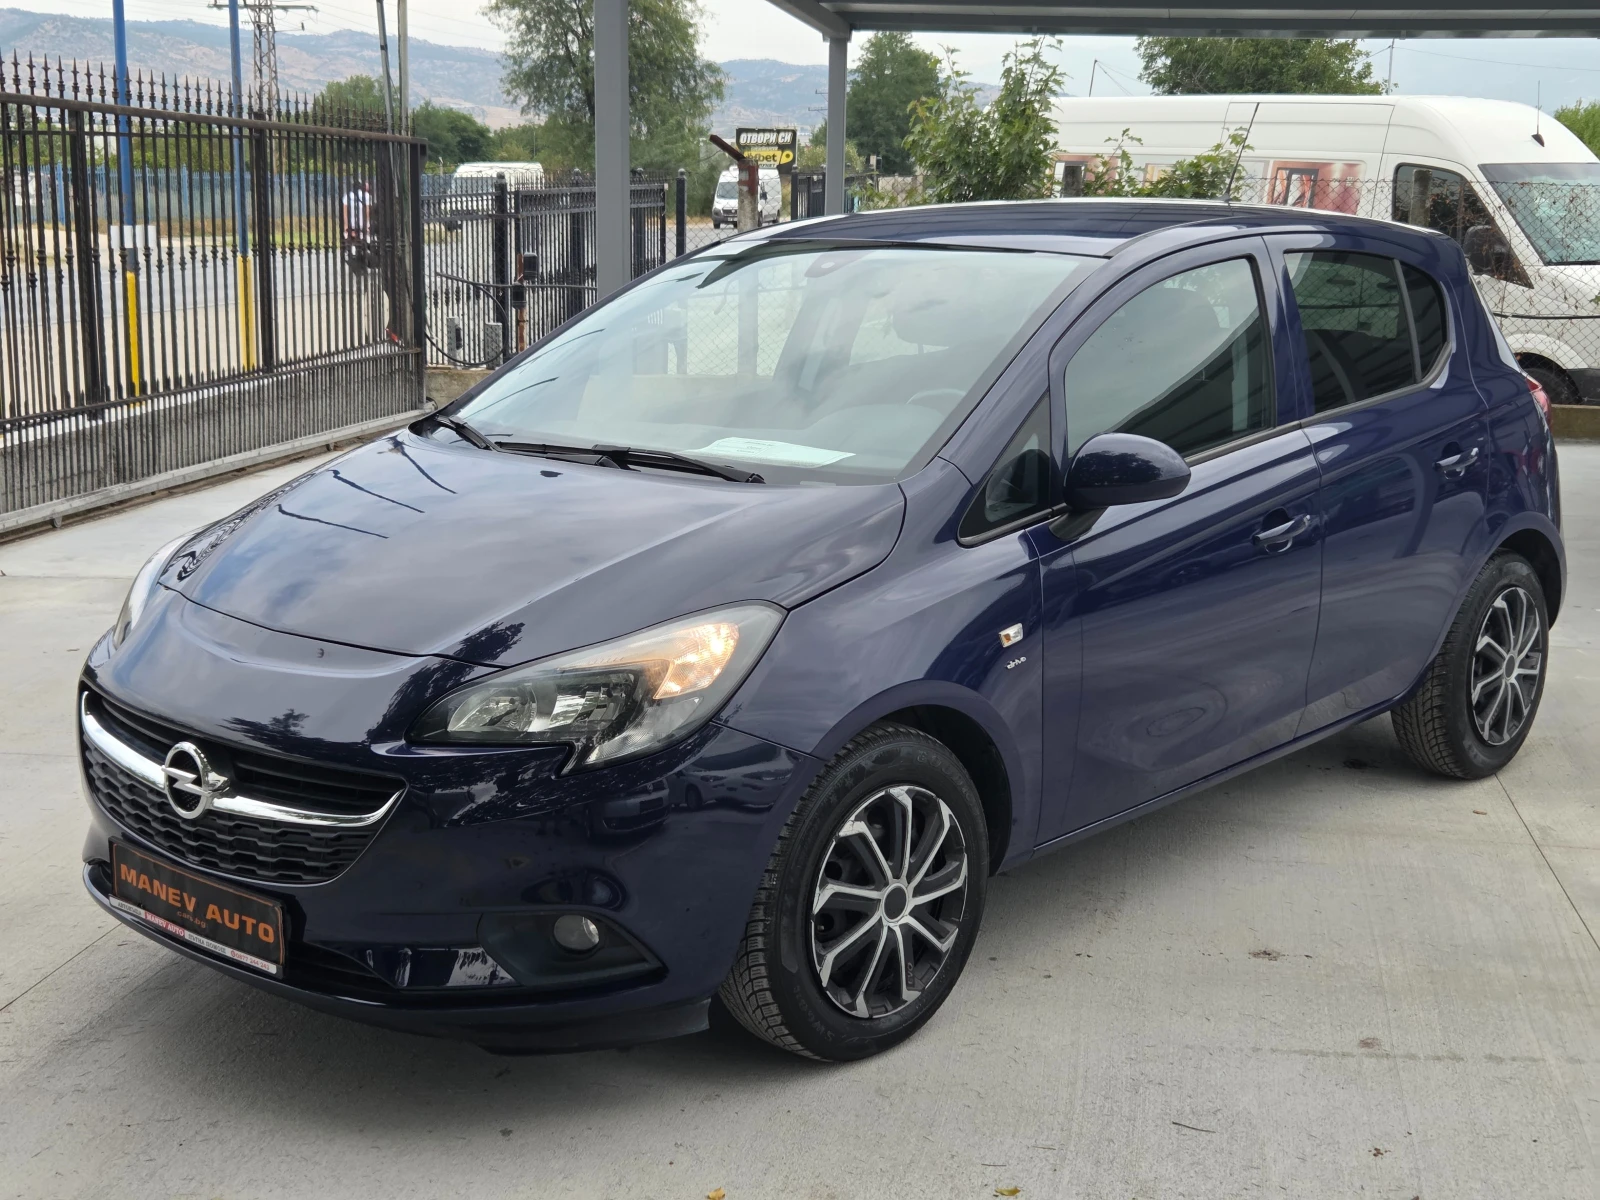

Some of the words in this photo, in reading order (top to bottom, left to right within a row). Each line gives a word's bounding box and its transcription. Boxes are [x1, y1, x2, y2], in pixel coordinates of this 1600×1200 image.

[739, 132, 778, 146] ОТВОРИ
[778, 131, 793, 145] СИ
[120, 863, 197, 913] MANEV
[205, 903, 276, 944] AUTO
[145, 911, 167, 928] MANEV
[167, 922, 185, 937] AUTO
[176, 910, 207, 929] cars.bg
